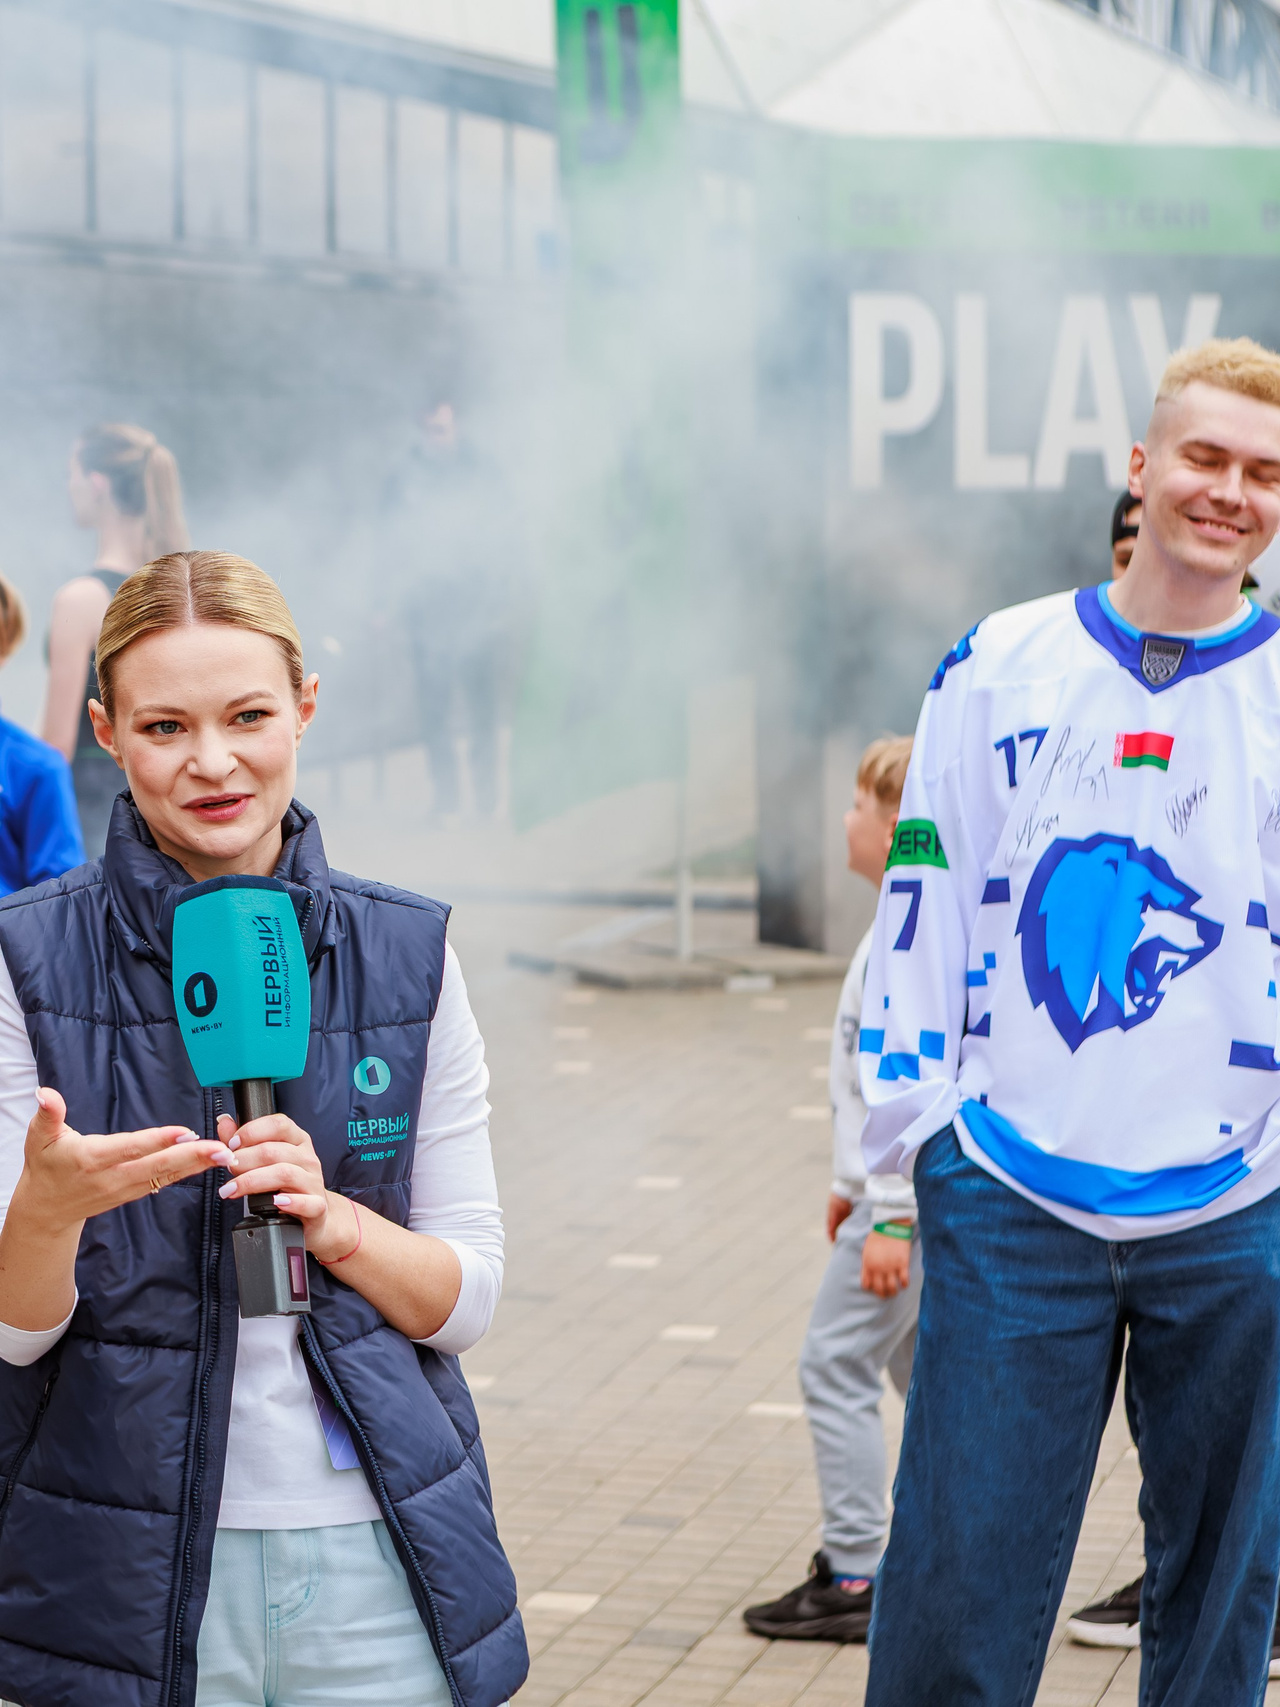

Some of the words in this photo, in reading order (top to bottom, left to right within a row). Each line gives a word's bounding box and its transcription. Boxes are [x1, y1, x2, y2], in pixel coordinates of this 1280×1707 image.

[994, 726, 1050, 789] 17
[890, 880, 922, 951] 7
[252, 915, 283, 1027] ПЕРВЫЙ
[274, 917, 291, 1028] ИНФОРМАЦИОННЫЙ
[347, 1112, 410, 1138] ПЕРВЫЙ
[348, 1132, 408, 1147] ИНФОРМАЦИОННЫЙ
